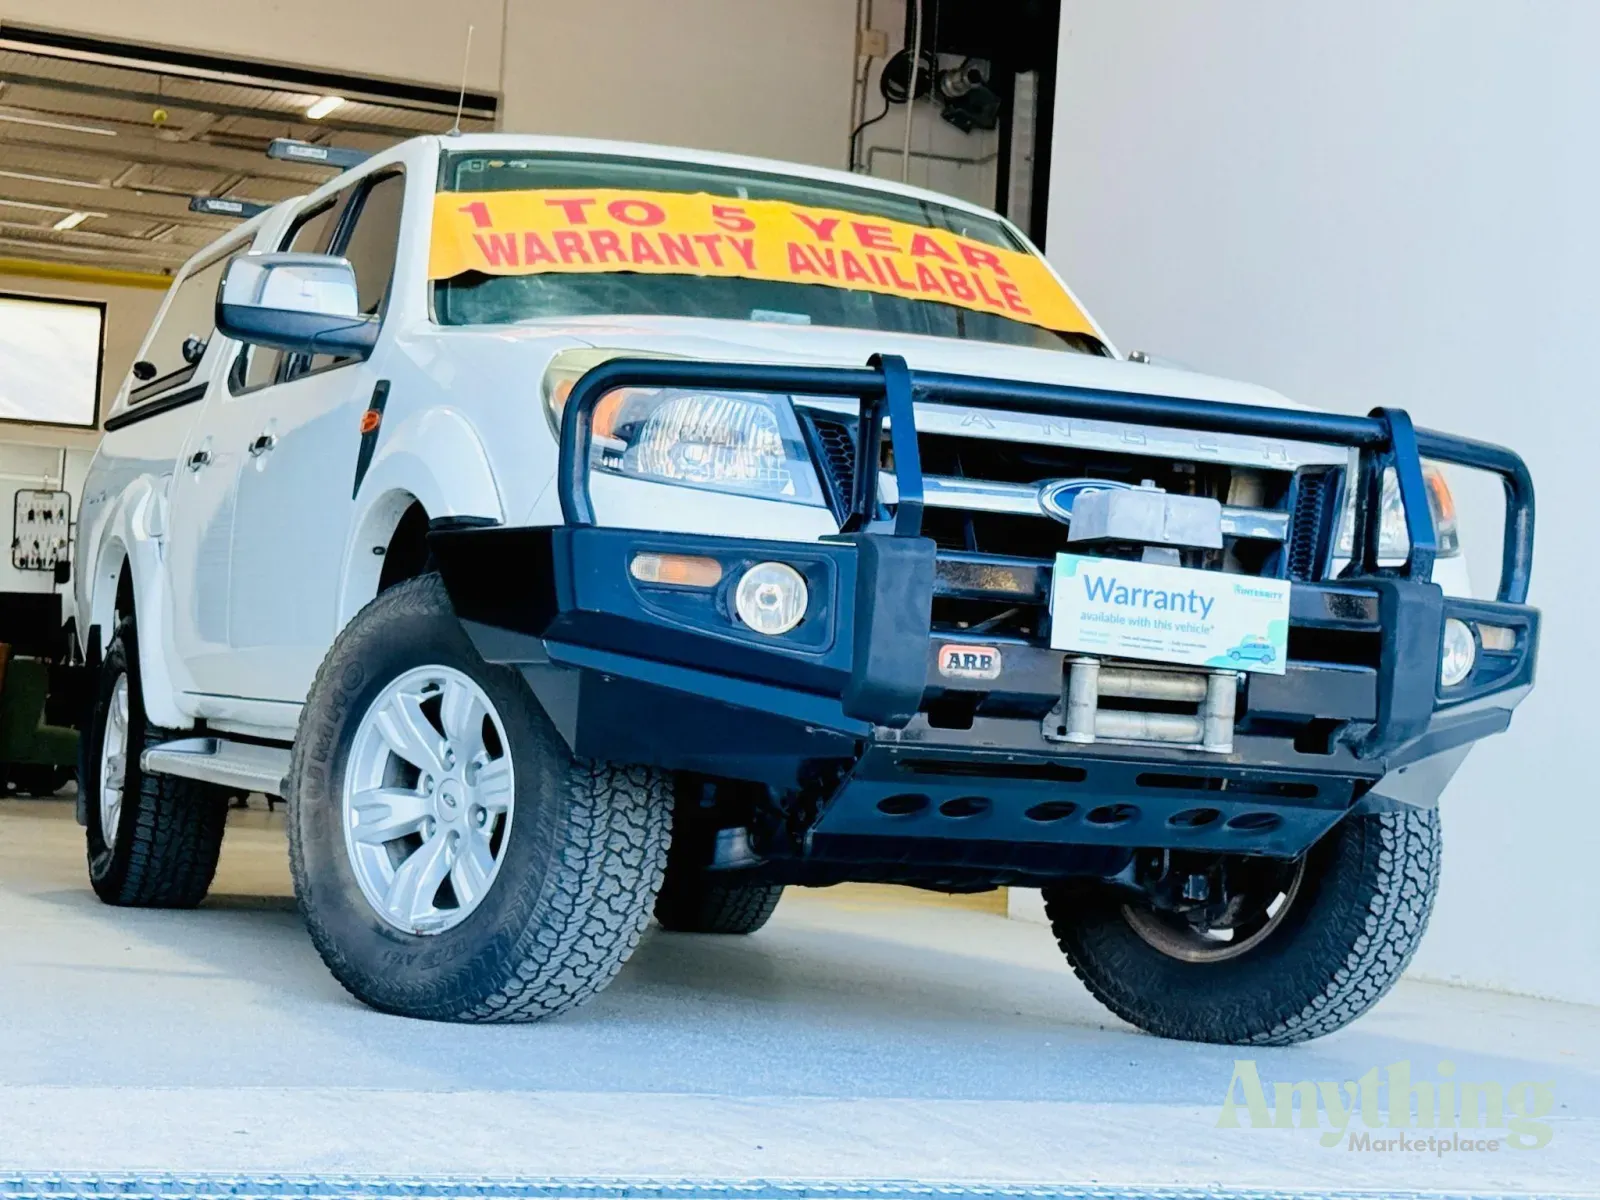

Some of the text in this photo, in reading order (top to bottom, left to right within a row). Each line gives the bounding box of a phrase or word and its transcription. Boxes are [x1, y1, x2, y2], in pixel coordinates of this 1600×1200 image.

[458, 198, 1011, 279] 1 TO 5 YEAR
[472, 229, 1033, 316] WARRANTY AVAILABLE
[1083, 574, 1215, 620] Warranty
[1080, 611, 1125, 625] available
[1128, 615, 1151, 629] with
[1153, 619, 1173, 631] this
[946, 652, 993, 671] ARB
